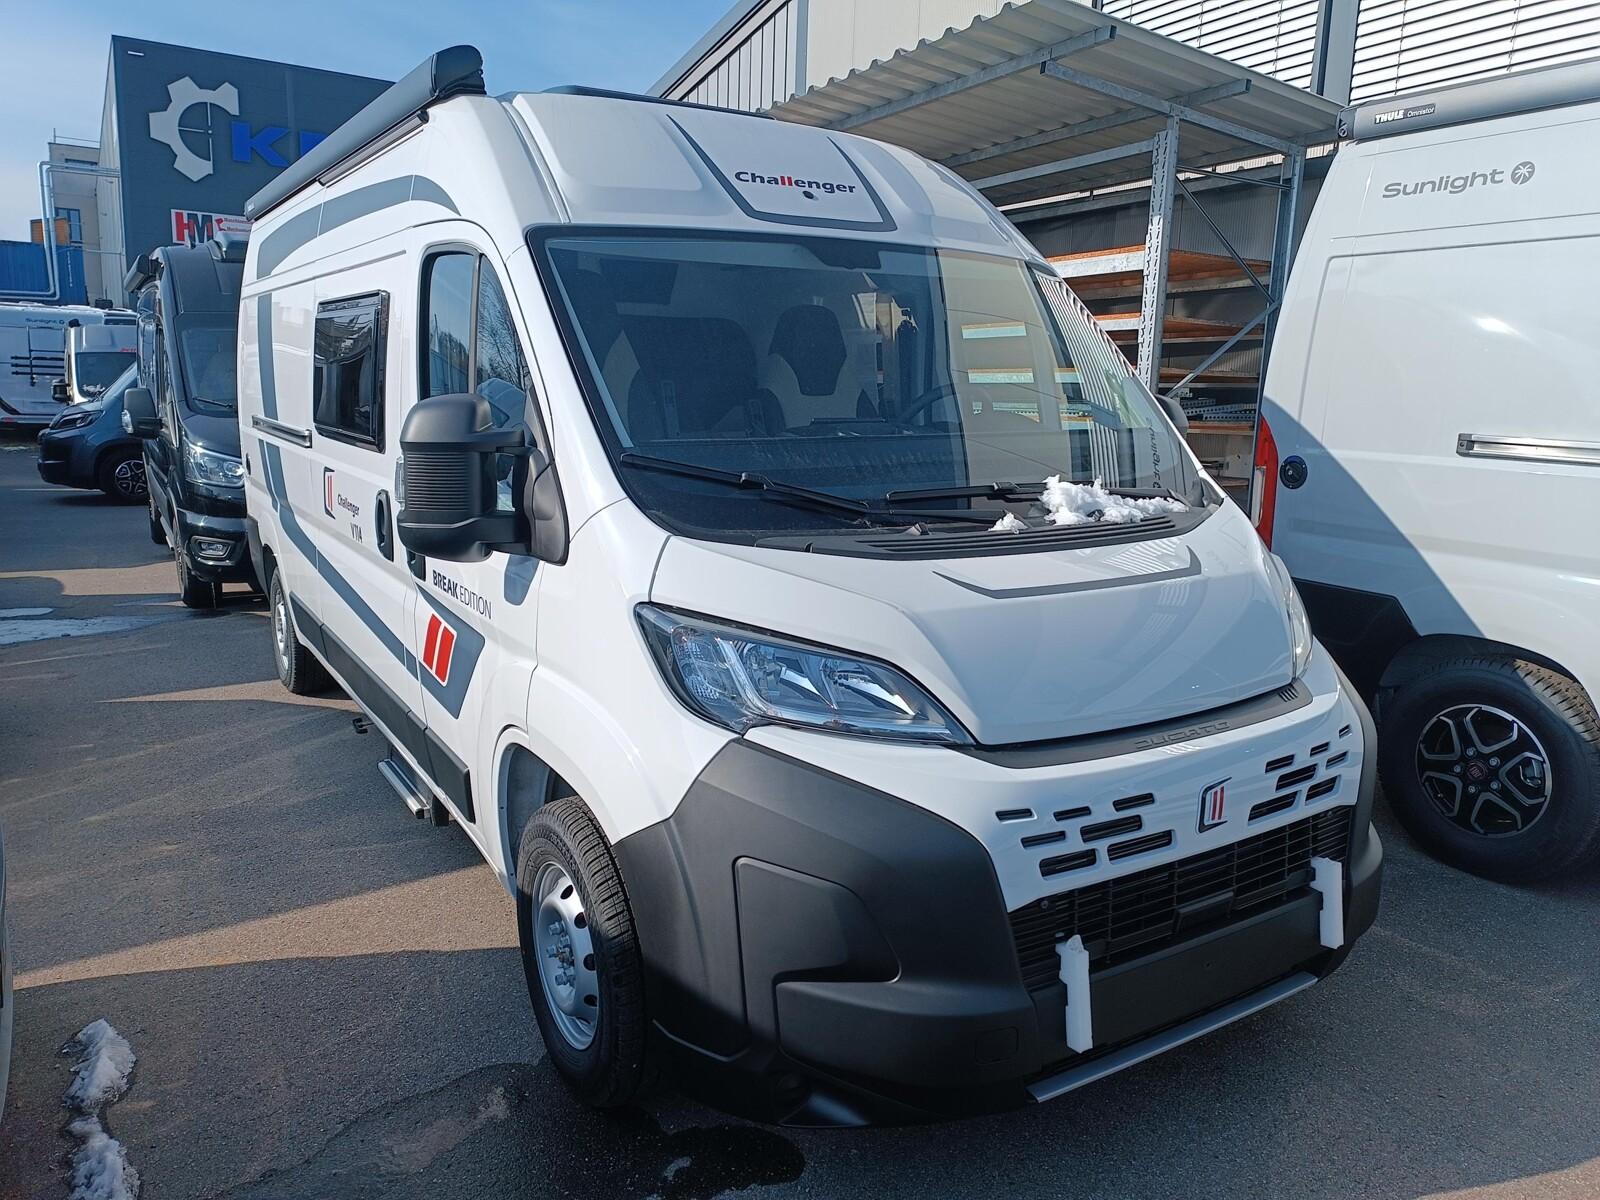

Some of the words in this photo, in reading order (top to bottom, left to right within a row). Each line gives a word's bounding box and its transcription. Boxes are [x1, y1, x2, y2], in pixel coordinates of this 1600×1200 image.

[1375, 110, 1404, 124] THULE
[1407, 107, 1435, 119] Omnistor
[734, 171, 856, 194] Challenger
[1382, 168, 1505, 199] Sunlight
[337, 493, 360, 518] Challenger
[432, 569, 459, 600] BREAK
[459, 584, 492, 620] EDITION
[1134, 720, 1231, 749] DUCATO
